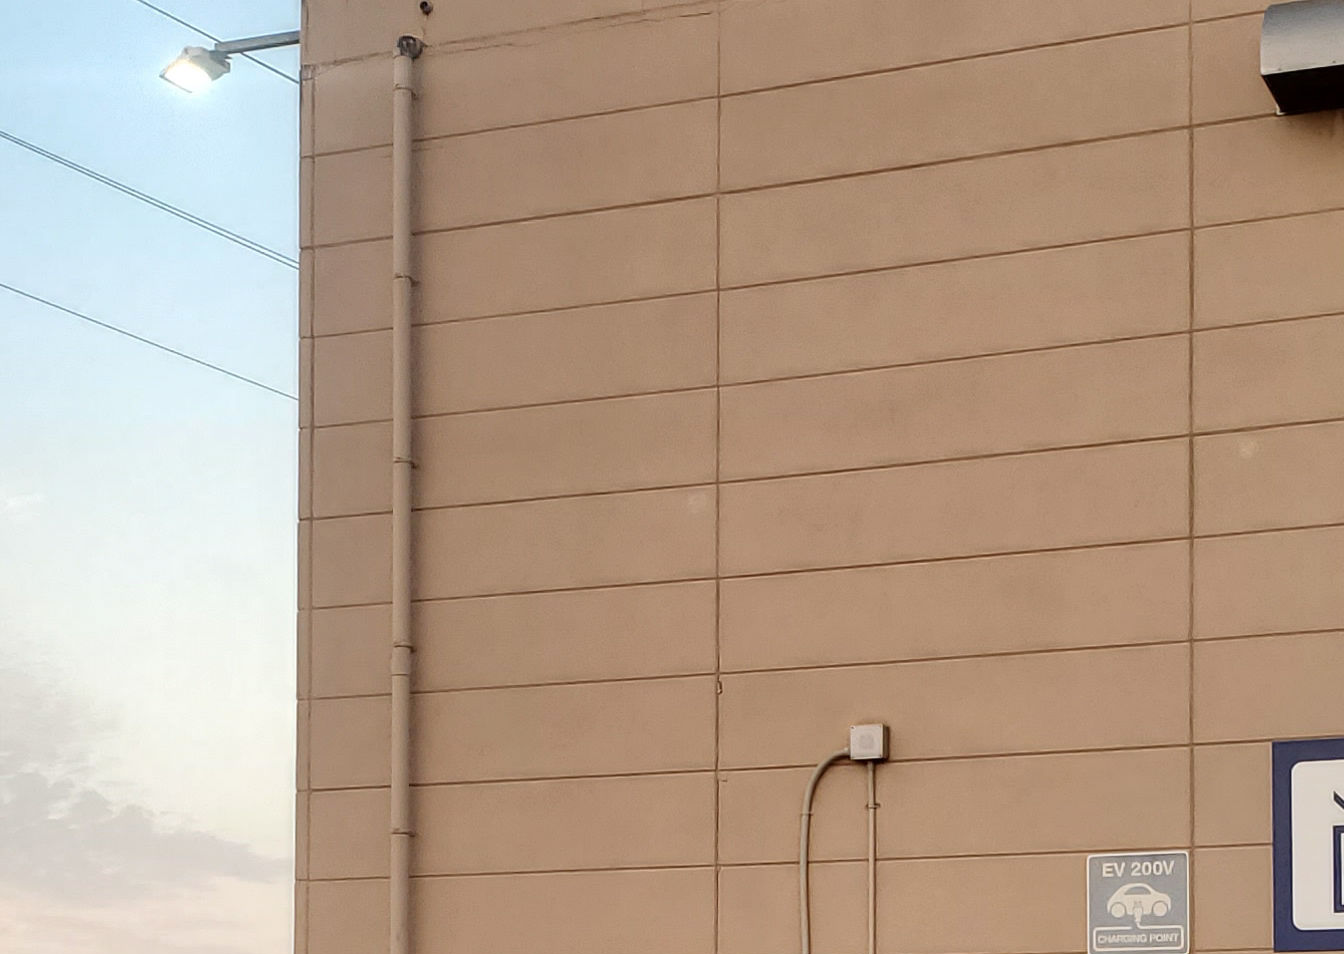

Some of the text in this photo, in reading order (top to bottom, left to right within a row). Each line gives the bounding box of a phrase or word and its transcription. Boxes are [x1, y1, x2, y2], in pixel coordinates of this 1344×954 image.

[1101, 859, 1175, 878] EV 200V
[1096, 932, 1180, 944] CHARGING POINT
